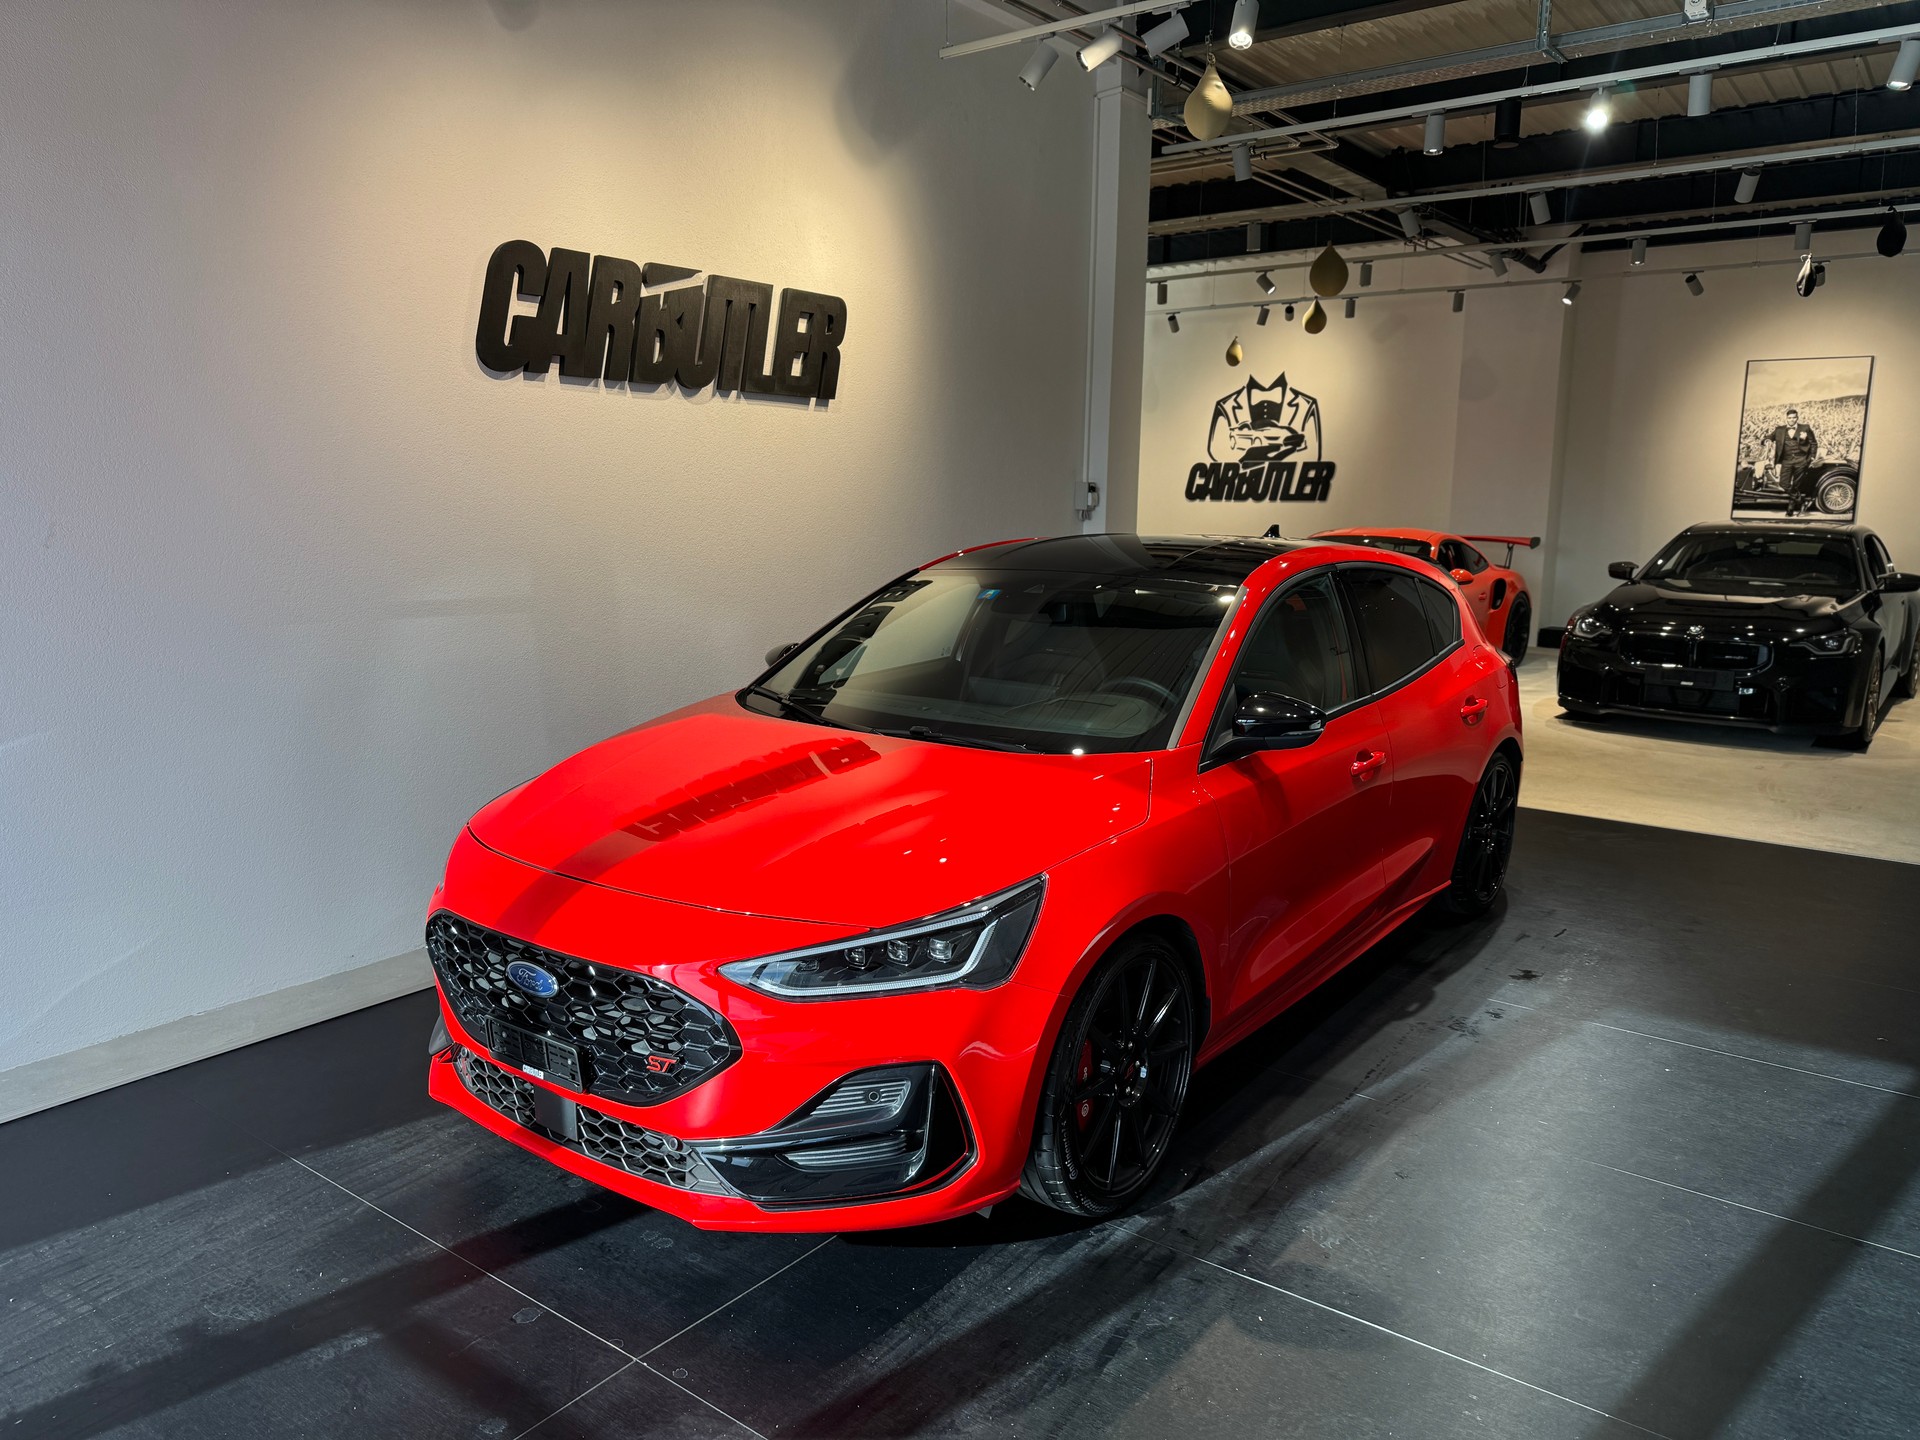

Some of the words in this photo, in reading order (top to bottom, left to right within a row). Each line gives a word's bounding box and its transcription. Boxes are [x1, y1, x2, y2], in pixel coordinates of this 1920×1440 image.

[475, 239, 848, 400] CARBUTLER
[1184, 461, 1337, 502] CARBUTLER
[516, 967, 544, 991] Ford
[646, 1055, 677, 1073] ST
